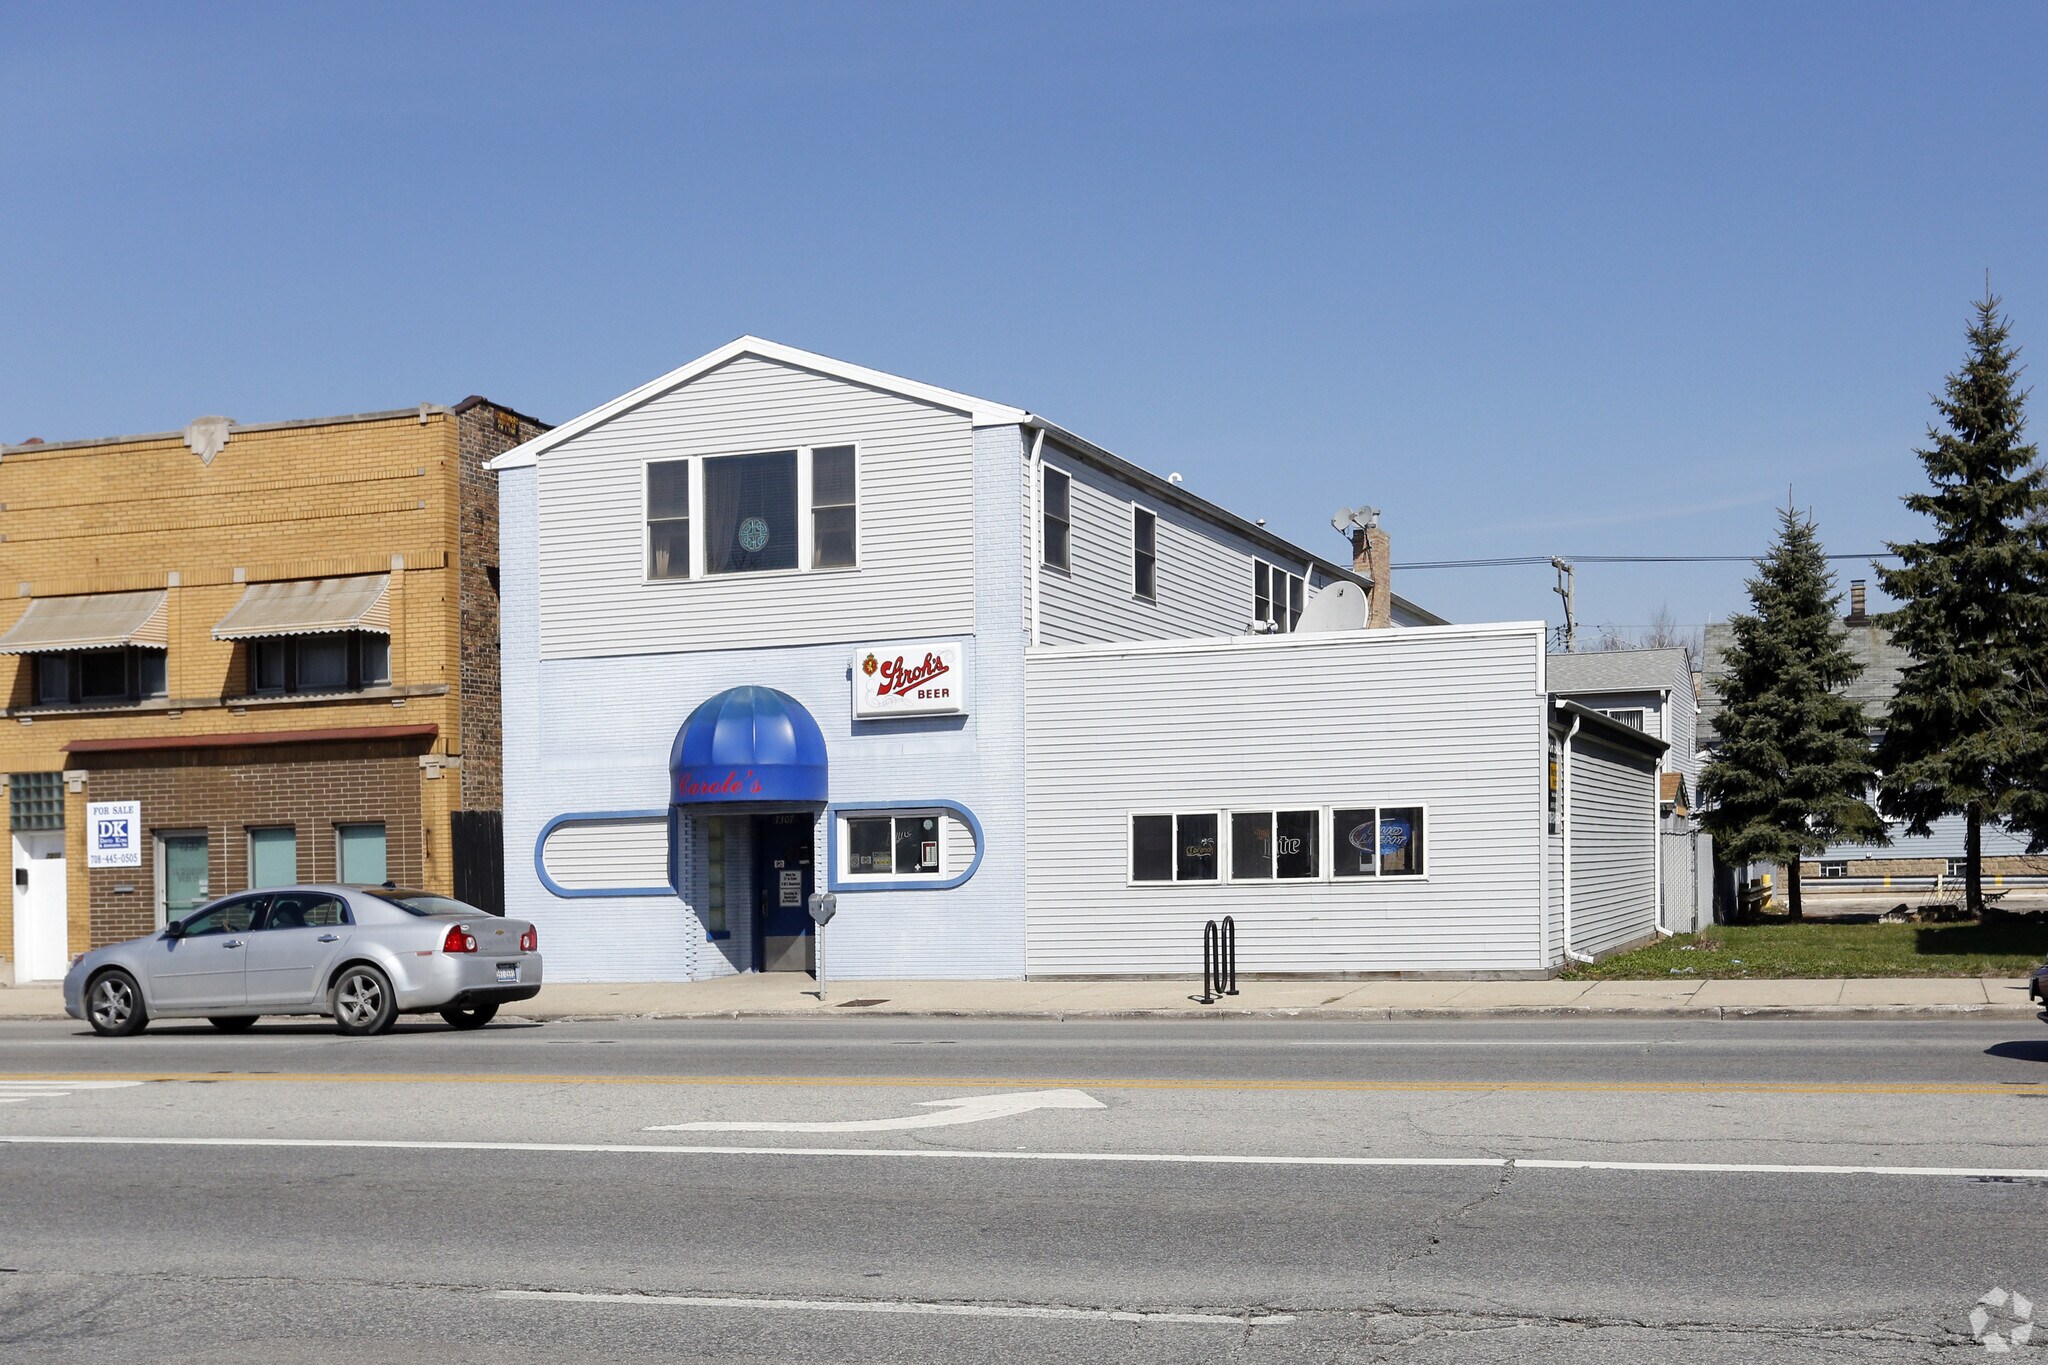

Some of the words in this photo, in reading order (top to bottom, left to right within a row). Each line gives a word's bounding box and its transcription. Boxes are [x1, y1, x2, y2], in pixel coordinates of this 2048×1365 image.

[877, 652, 949, 697] Stroh's
[918, 688, 949, 699] BEER
[677, 769, 763, 796] Carole's
[93, 806, 109, 815] FOR
[112, 805, 134, 815] SALE
[99, 820, 128, 838] DK
[91, 853, 138, 864] 708-445-0505
